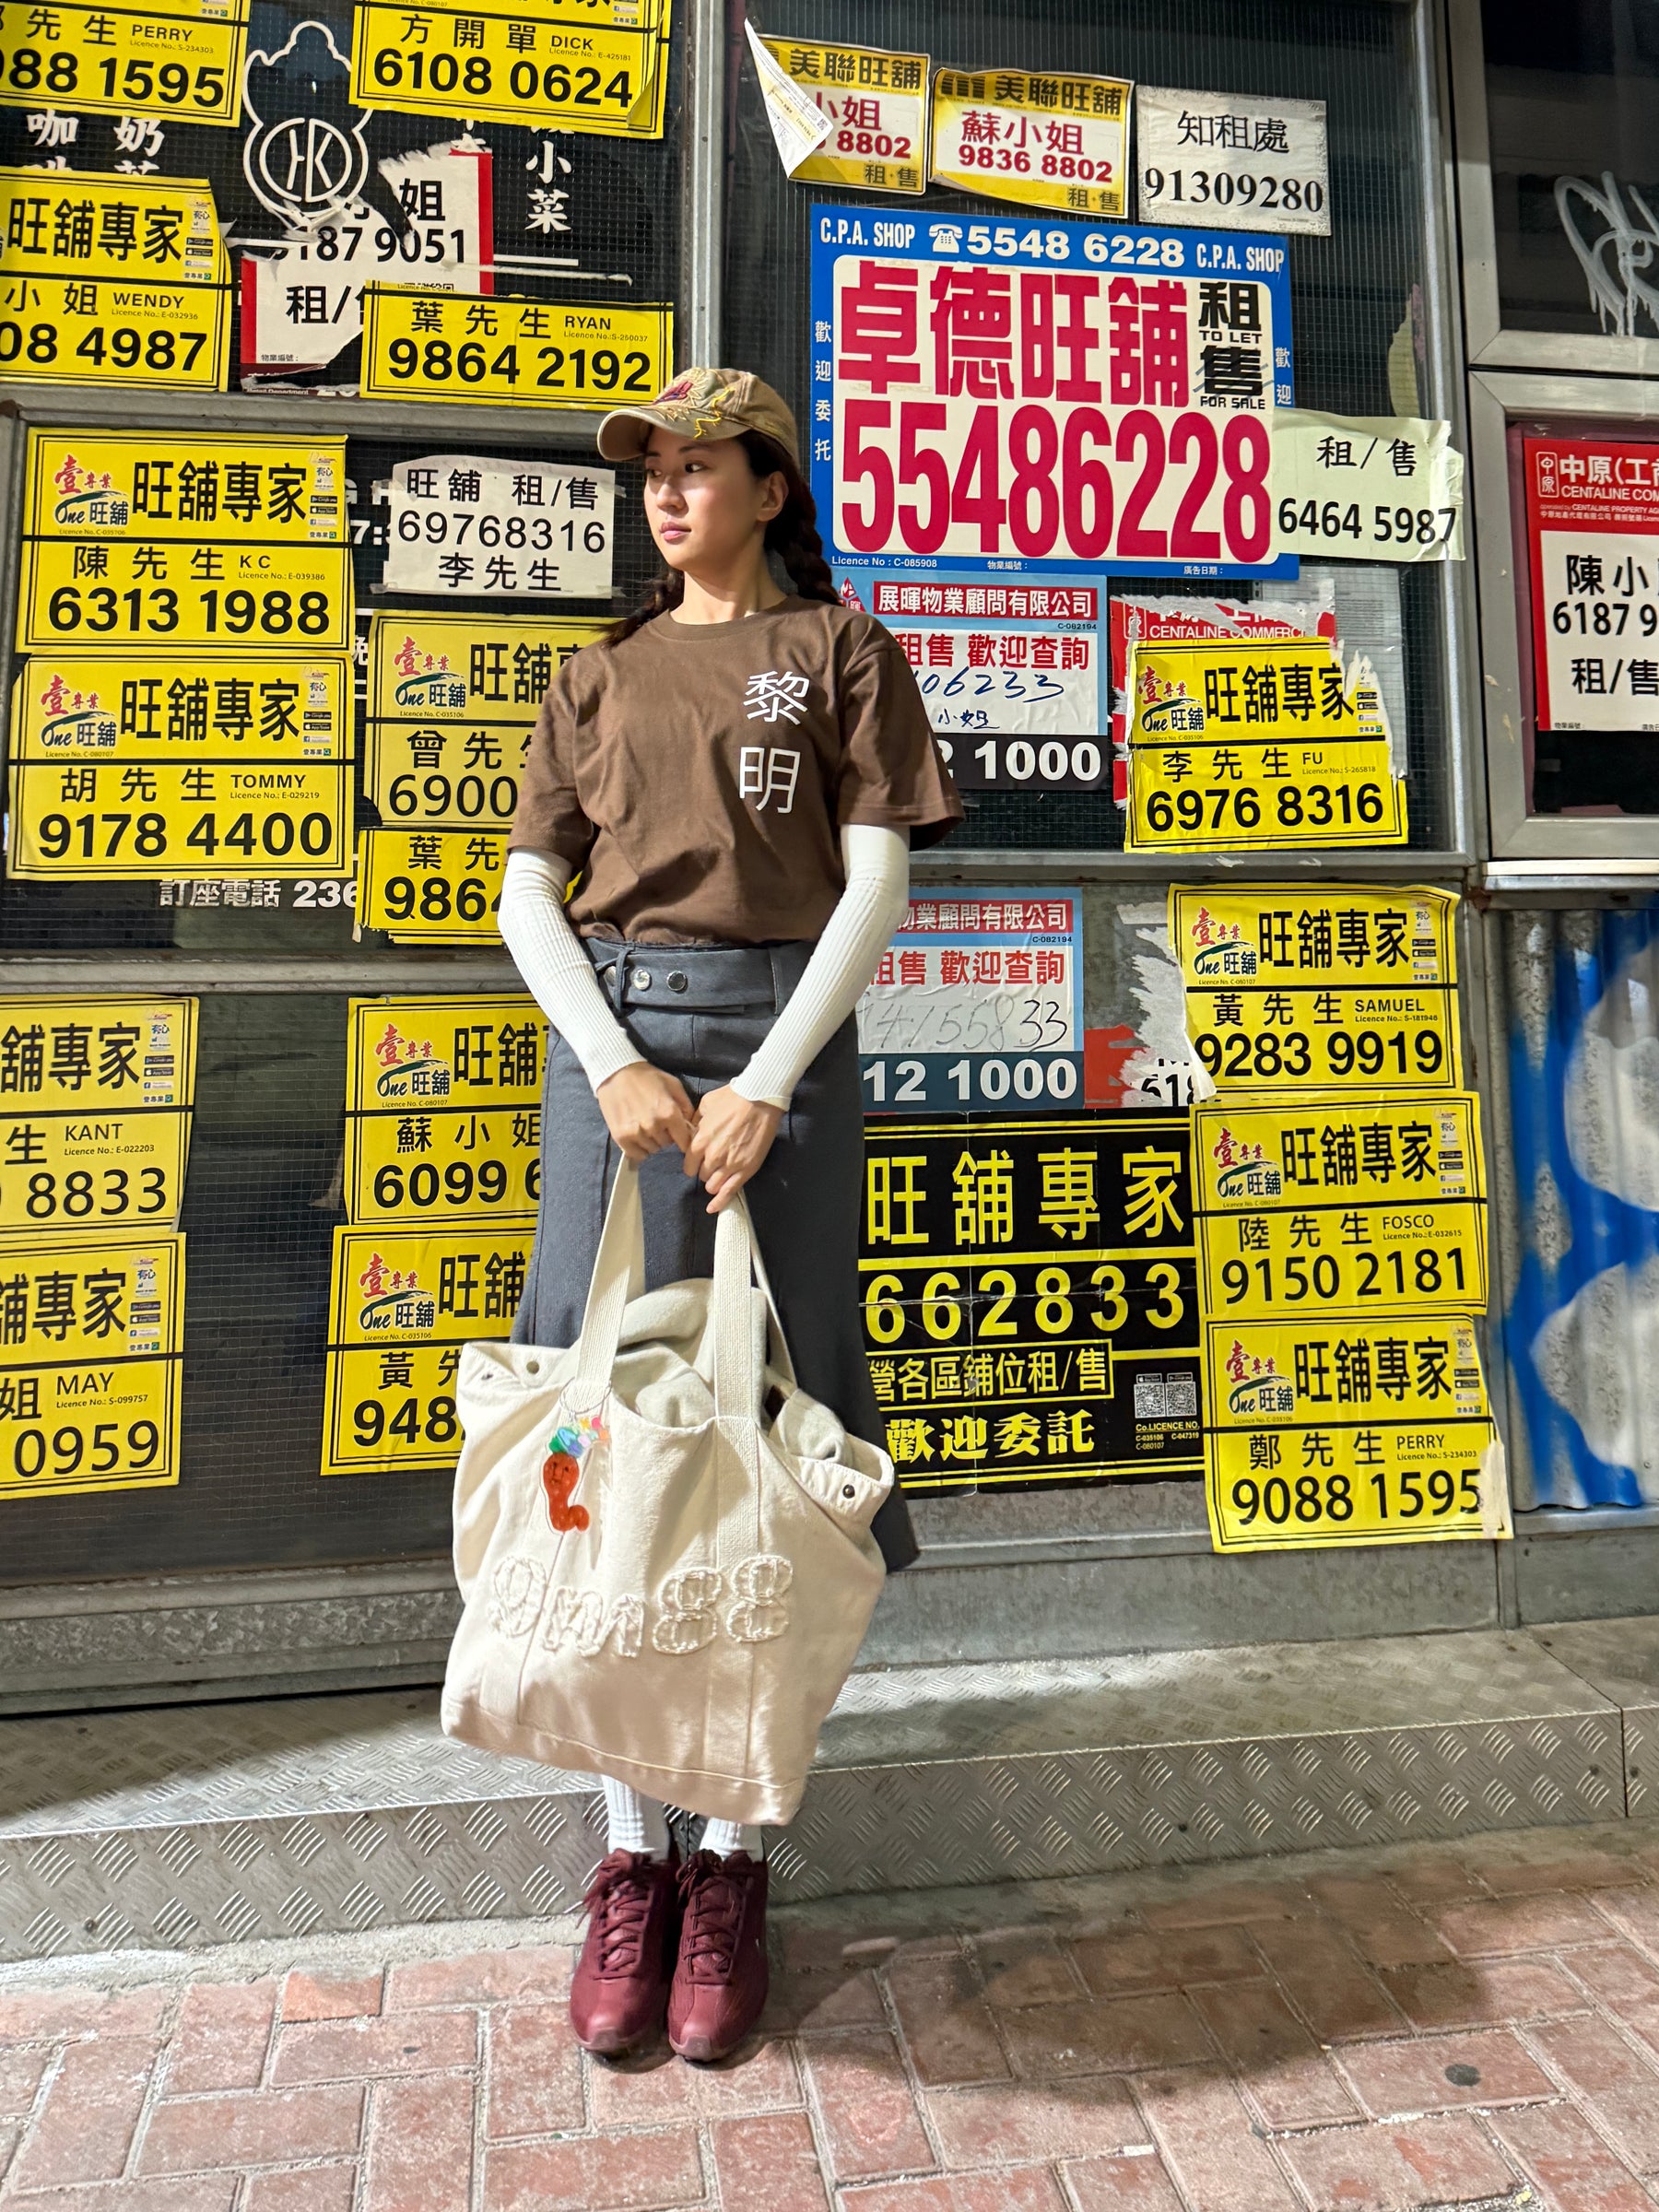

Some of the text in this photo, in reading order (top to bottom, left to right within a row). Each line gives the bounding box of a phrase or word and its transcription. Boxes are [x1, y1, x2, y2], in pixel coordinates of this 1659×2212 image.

[0, 6, 117, 46] 先生
[130, 40, 159, 49] Licence
[132, 24, 194, 41] PERRY
[400, 14, 537, 54] 方開單
[551, 34, 594, 51] DICK
[549, 48, 579, 57] Licence
[790, 51, 923, 90] 美聯旺舖
[99, 56, 225, 108] 1595
[374, 48, 632, 108] 6108 0624
[994, 75, 1123, 116] 美聯旺舖
[961, 110, 1084, 156] 蘇小姐
[1177, 112, 1289, 155] 知租處
[959, 144, 1112, 183] 9836 8802
[1145, 166, 1324, 213] 91309280
[8, 196, 183, 265] 旺舖專家
[374, 227, 465, 264] 9051
[819, 216, 916, 250] C.P.A. SHOP
[966, 226, 1185, 268] 5548 6228
[1195, 247, 1285, 274] C.P.A. SHOP
[5, 281, 99, 317] 小姐
[112, 290, 185, 310] WENDY
[112, 308, 142, 318] Licence
[1198, 280, 1262, 333] 租
[411, 300, 553, 339] 葉先生
[565, 315, 611, 330] RYAN
[838, 259, 1190, 408] 卓德旺舖
[1199, 330, 1263, 345] TO LET
[76, 326, 207, 371] 4987
[388, 337, 653, 393] 9864 2192
[1200, 344, 1265, 397] 售
[1200, 395, 1266, 410] FOR SALE
[1316, 435, 1418, 477] 租/售
[132, 460, 307, 524] 旺舖專家
[406, 468, 482, 503] 旺舖
[512, 473, 599, 511] 租/售
[841, 397, 1272, 564] 55486228
[1560, 485, 1631, 500] CENTALINE
[54, 499, 129, 526] One 旺舖
[1278, 497, 1457, 546] 6464 5987
[398, 510, 606, 554] 69768316
[72, 546, 226, 582] 陳先生
[238, 571, 268, 580] Licence
[439, 552, 563, 593] 李先生
[831, 556, 937, 569] Licence C-085908
[1565, 555, 1659, 597] 陳小
[49, 586, 330, 636] 6313 1988
[878, 584, 1092, 618] 展暉物業顧問有限公司
[1553, 601, 1658, 637] 6187 9
[1057, 622, 1098, 630] C-082194
[1150, 624, 1228, 639] CENTALINE
[967, 634, 1089, 671] 歡迎查詢
[394, 682, 466, 709] One 旺舖
[1204, 663, 1355, 724] 旺舖專家
[1571, 657, 1659, 697] 租/售
[120, 677, 300, 742] 旺舖專家
[1140, 707, 1205, 733] One 旺舖
[41, 720, 117, 747] One 旺舖
[738, 670, 810, 815] 黎明
[974, 739, 1101, 782] 1000
[1162, 747, 1292, 783] 李先生
[1301, 752, 1324, 765] FU
[1302, 767, 1327, 775] Licence
[60, 768, 217, 804] 胡先生
[229, 791, 320, 800] Licence E-029219
[230, 774, 307, 789] TOMMY
[389, 774, 518, 818] 6900
[1147, 782, 1383, 832] 6976 8316
[39, 812, 333, 859] 9178 4400
[1031, 935, 1073, 944] C-082194
[1258, 908, 1410, 970] 旺舖專家
[940, 950, 1065, 985] 歡迎查詢
[1194, 950, 1257, 976] One 旺舖
[1213, 992, 1344, 1028] 黃先生
[1354, 998, 1425, 1013] SAMUEL
[1355, 1015, 1384, 1024] Licence
[1194, 1030, 1442, 1078] 9283 9919
[376, 1069, 451, 1097] One 旺舖
[863, 1058, 1078, 1102] 12 1000
[64, 1144, 155, 1156] Licence E-022203
[65, 1123, 124, 1142] KANT
[1280, 1121, 1437, 1187] 旺舖專家
[26, 1167, 167, 1218] 8833
[373, 1159, 507, 1208] 6099
[866, 1146, 1184, 1245] 旺舖專家
[1217, 1171, 1282, 1198] One 旺舖
[1238, 1211, 1372, 1253] 陸先生
[1382, 1215, 1435, 1230] FOSCO
[1221, 1247, 1465, 1305] 9150 2181
[359, 1300, 435, 1330] One 旺舖
[865, 1263, 1184, 1344] 662833
[56, 1371, 115, 1395] MAY
[1293, 1335, 1453, 1404] 旺舖專家
[56, 1394, 149, 1409] Licence S-099757
[1229, 1385, 1294, 1415] One 旺舖
[14, 1419, 159, 1477] 0959
[1249, 1430, 1385, 1471] 鄭先生
[1396, 1434, 1445, 1450] PERRY
[1396, 1453, 1425, 1461] Licence
[1231, 1468, 1483, 1526] 9088 1595
